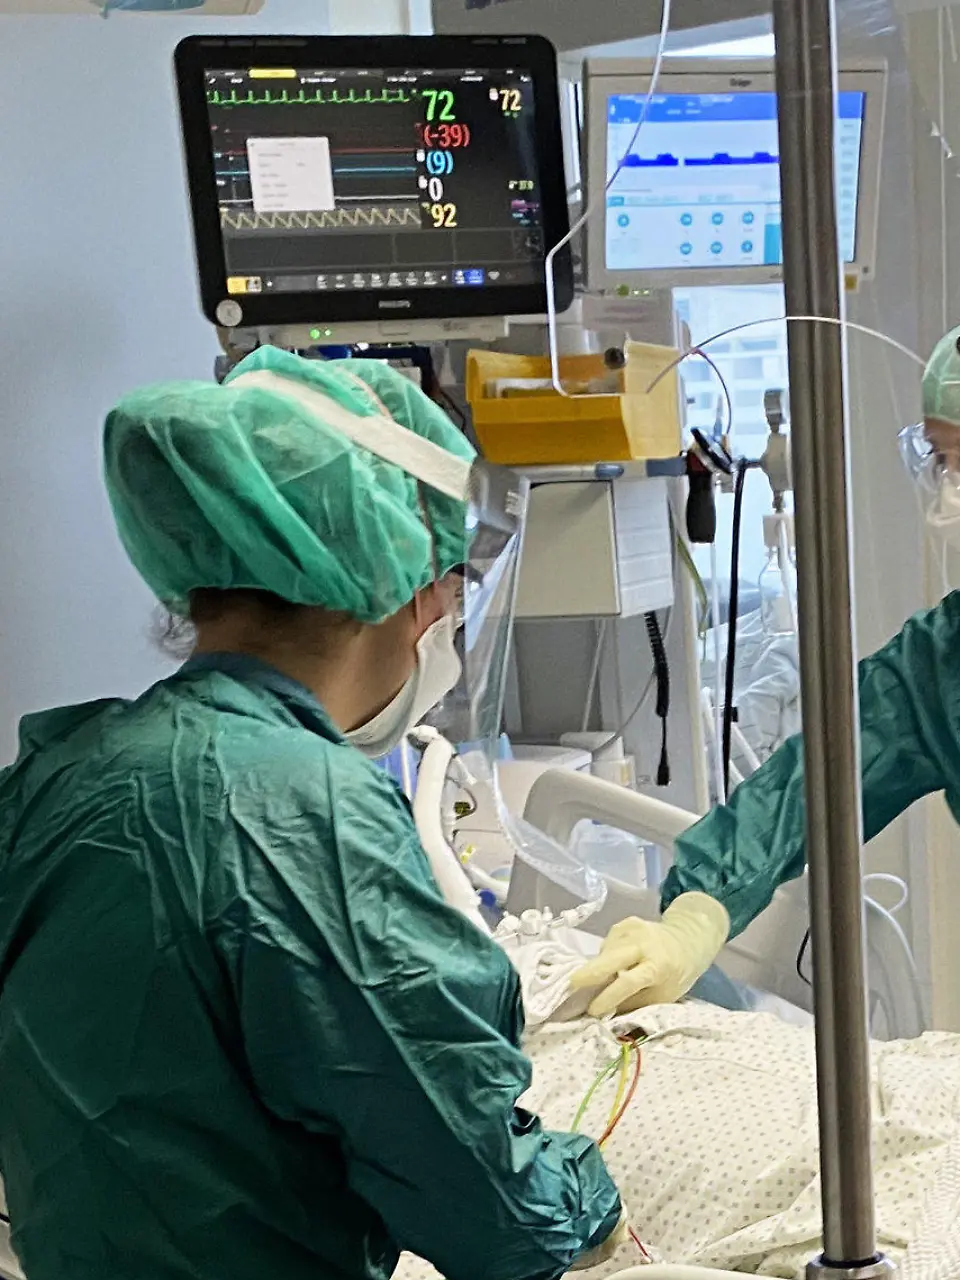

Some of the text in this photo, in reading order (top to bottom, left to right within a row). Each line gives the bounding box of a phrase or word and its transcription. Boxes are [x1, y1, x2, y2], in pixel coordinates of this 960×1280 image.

[422, 88, 456, 122] 72
[499, 89, 523, 111] 72
[423, 123, 471, 148] (-39)
[425, 149, 454, 175] (9)
[428, 176, 444, 202] 0
[430, 202, 458, 229] 92
